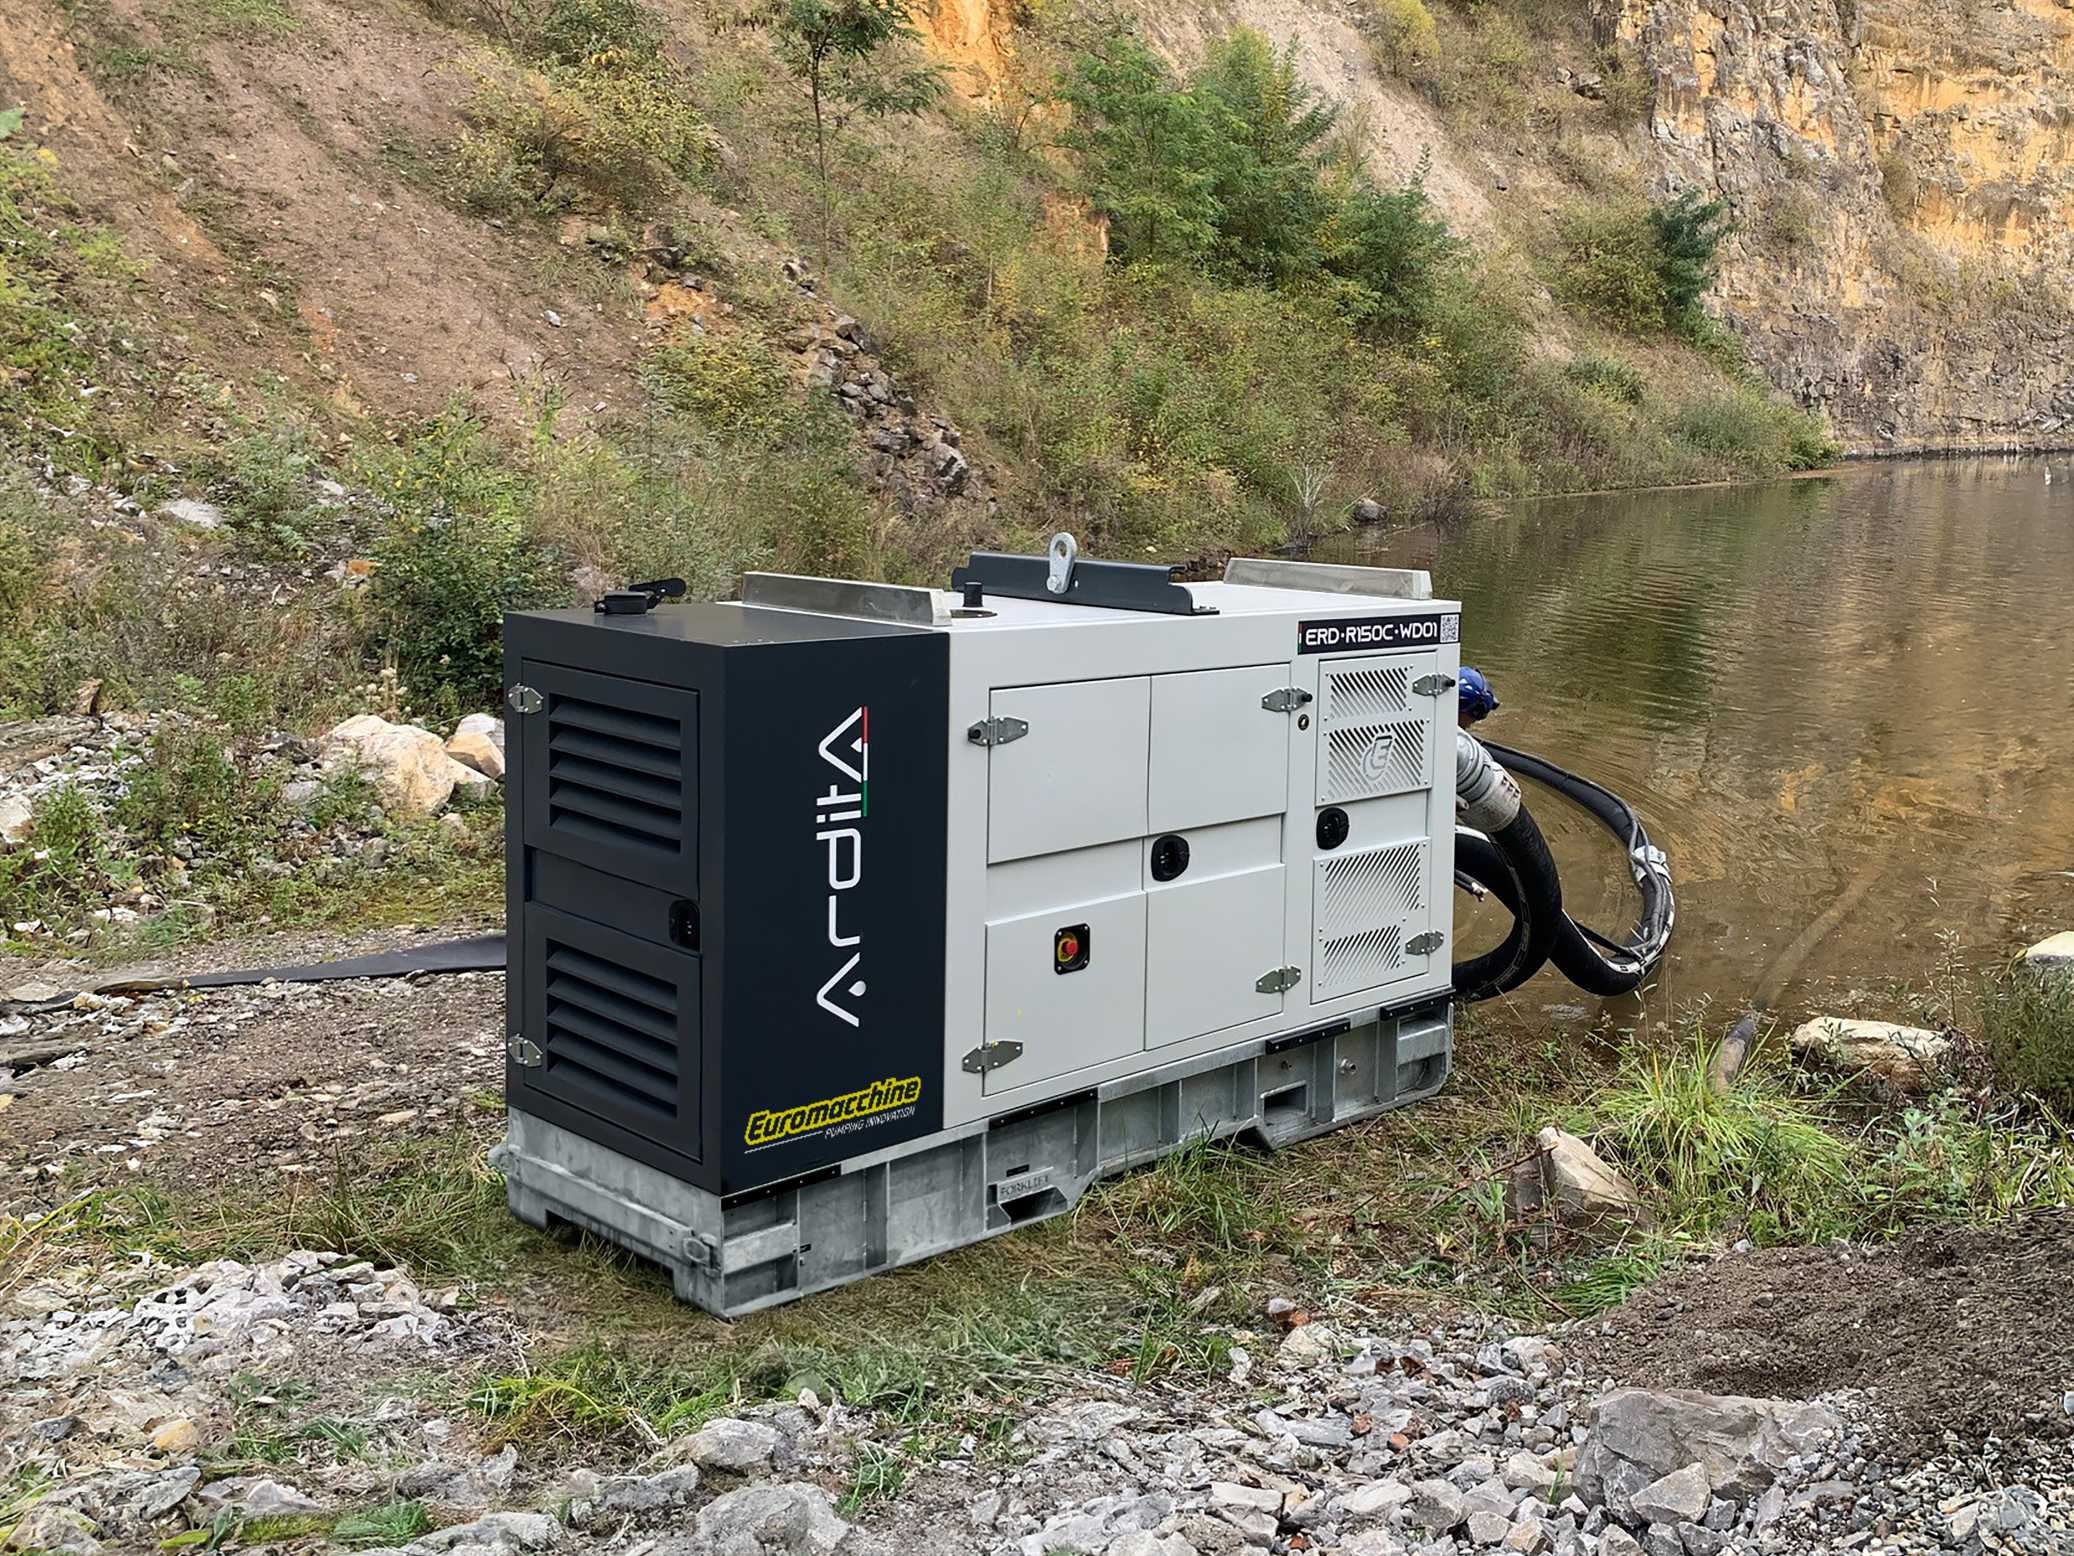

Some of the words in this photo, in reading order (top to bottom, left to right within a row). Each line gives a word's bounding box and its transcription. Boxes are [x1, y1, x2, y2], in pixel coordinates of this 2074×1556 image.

[745, 1077, 921, 1145] Euromacchine
[824, 1119, 865, 1139] PUMPING
[1001, 1175, 1049, 1195] FORKLIFT
